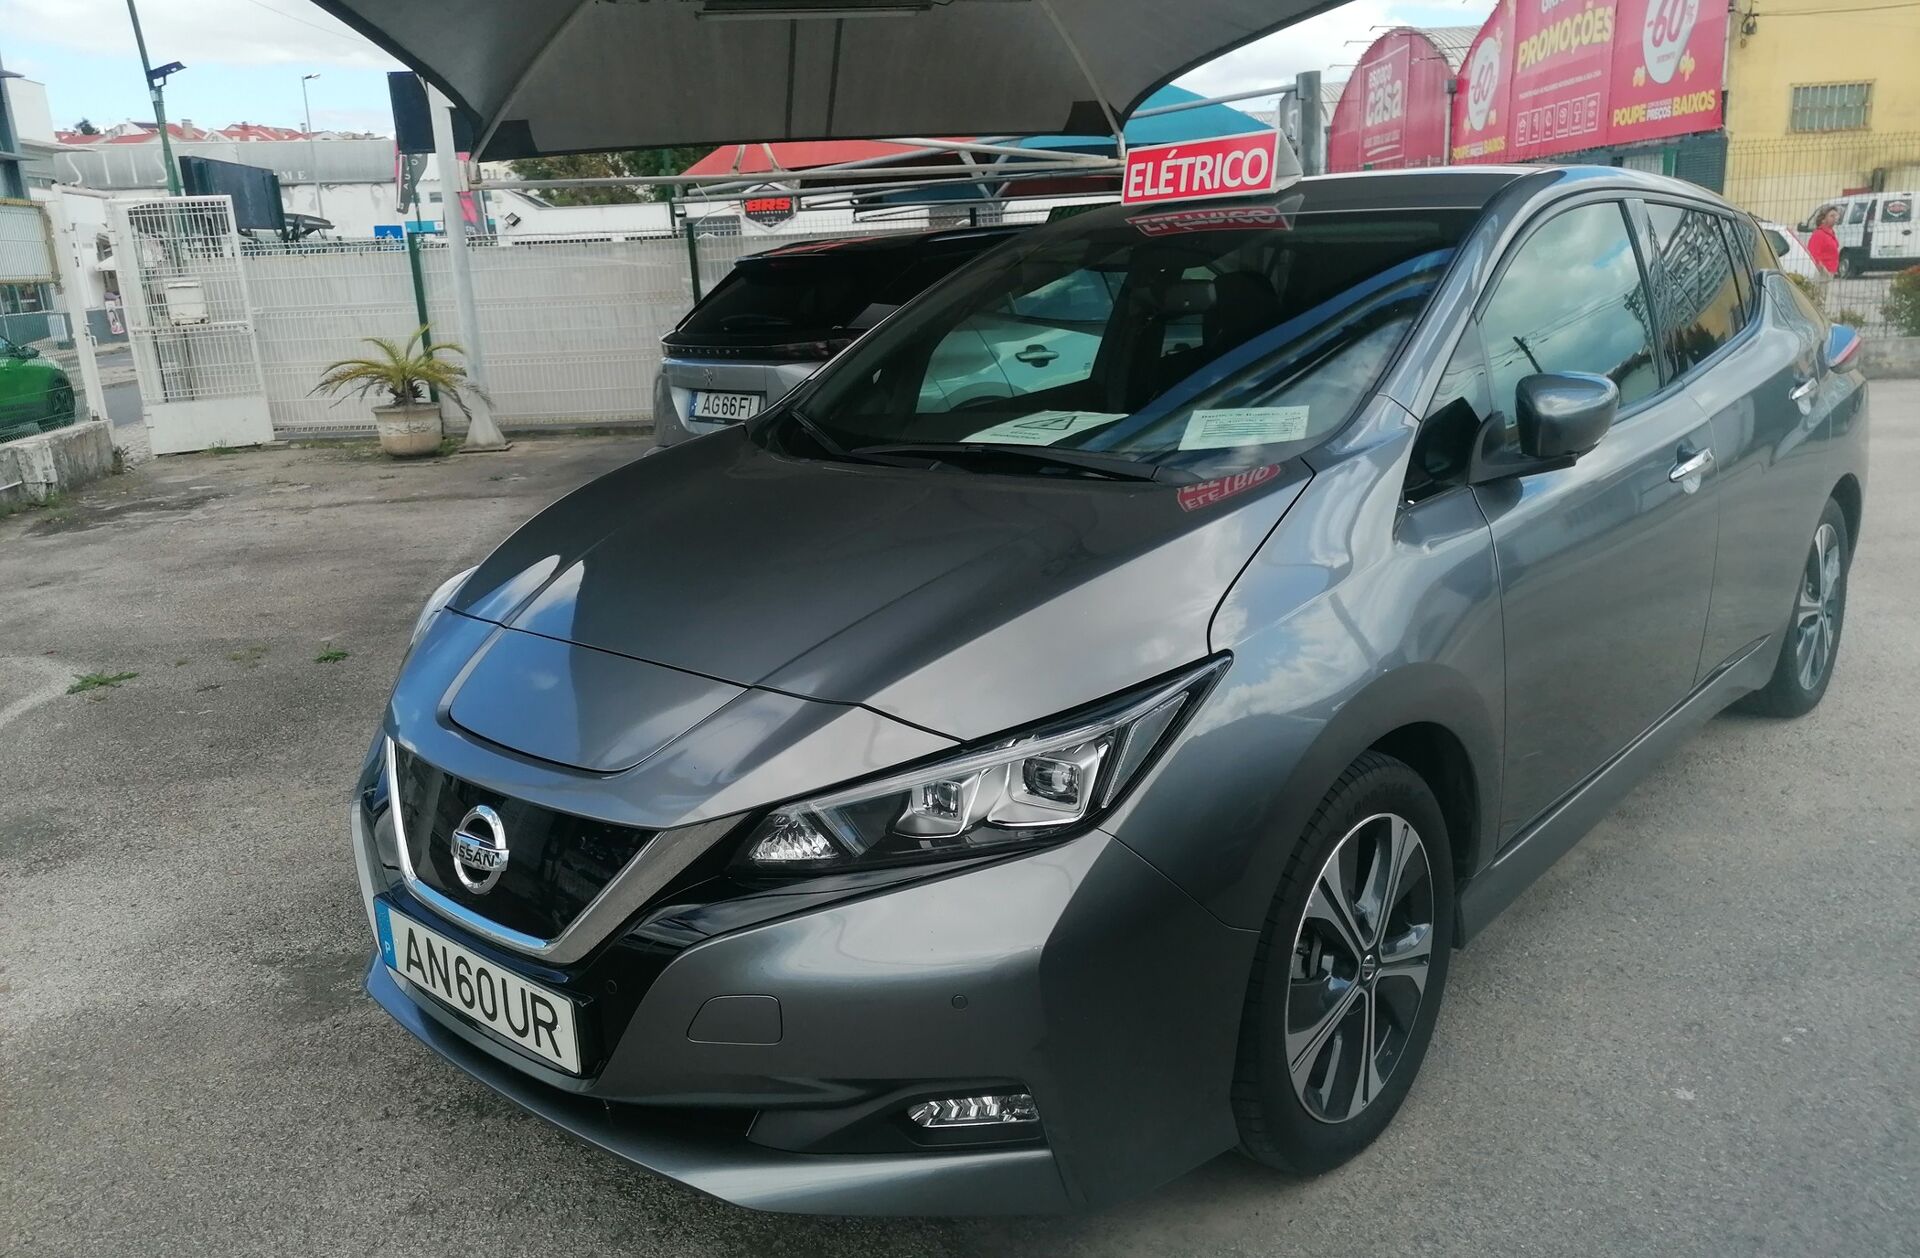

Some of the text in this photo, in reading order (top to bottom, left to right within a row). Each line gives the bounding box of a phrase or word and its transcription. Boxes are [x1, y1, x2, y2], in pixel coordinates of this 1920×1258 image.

[1517, 1, 1613, 73] PROMOÇÕES
[1366, 79, 1403, 127] casa
[1613, 103, 1647, 127] POUPE
[1672, 88, 1716, 117] BAIXOS
[1128, 149, 1269, 198] ELÉTRICO
[746, 198, 790, 212] BRS
[702, 395, 752, 418] AG66FI
[406, 926, 563, 1059] AN60UR
